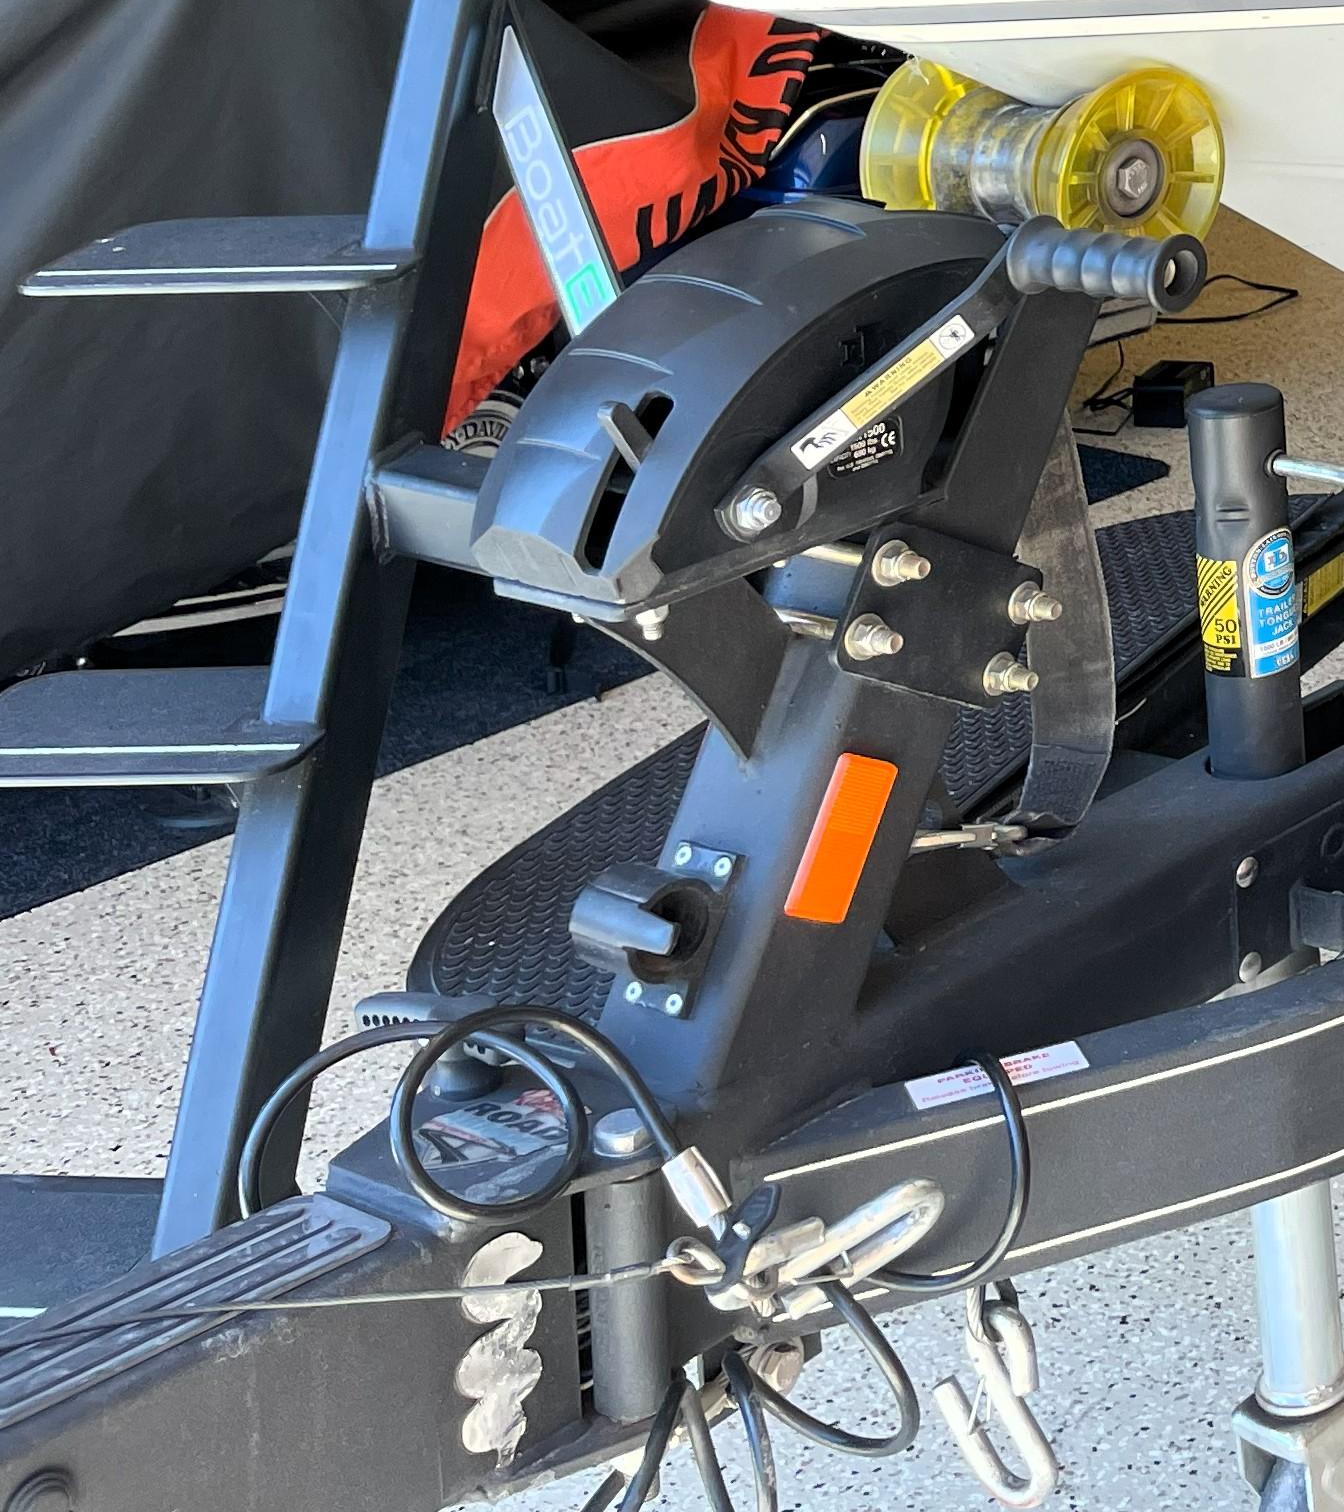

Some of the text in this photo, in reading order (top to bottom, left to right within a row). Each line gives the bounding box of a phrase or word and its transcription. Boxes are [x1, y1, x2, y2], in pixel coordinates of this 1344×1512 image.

[880, 430, 896, 447] CE
[1214, 618, 1238, 634] 50
[1215, 633, 1237, 645] PSI
[1003, 1052, 1051, 1068] BRAKE
